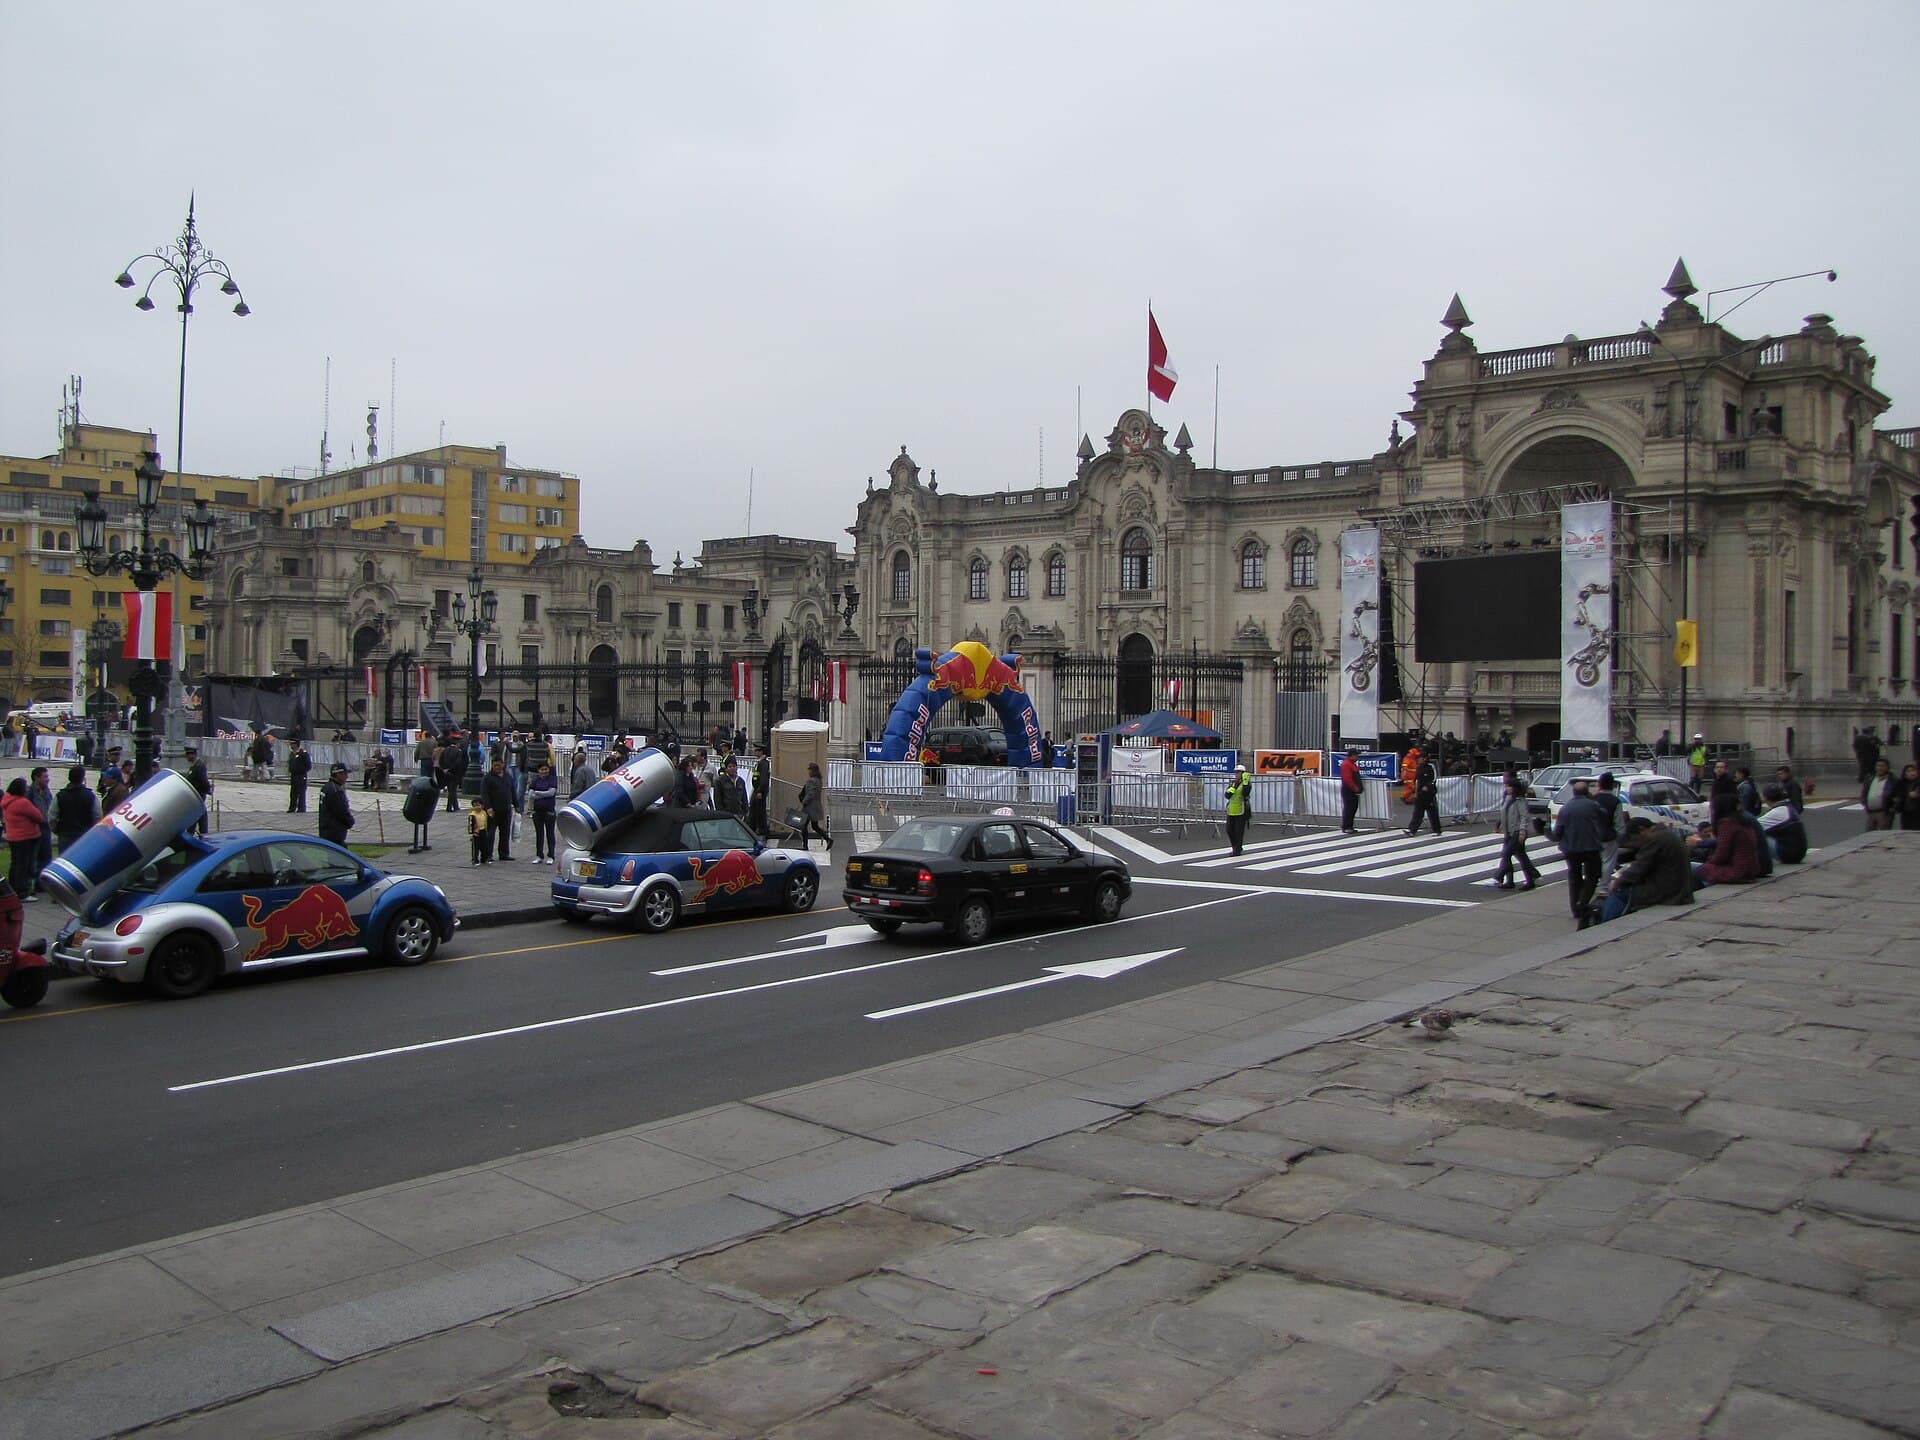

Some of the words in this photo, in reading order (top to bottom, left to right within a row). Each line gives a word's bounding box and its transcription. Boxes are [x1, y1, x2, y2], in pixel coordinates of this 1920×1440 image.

[217, 729, 238, 740] Red
[904, 732, 920, 761] Red
[912, 704, 930, 736] Bull
[1021, 707, 1038, 737] Red
[1029, 735, 1041, 762] Bull
[1182, 756, 1228, 764] SAMSUNG
[1260, 754, 1305, 768] KTM
[616, 766, 645, 789] Bull
[116, 801, 153, 831] Bull
